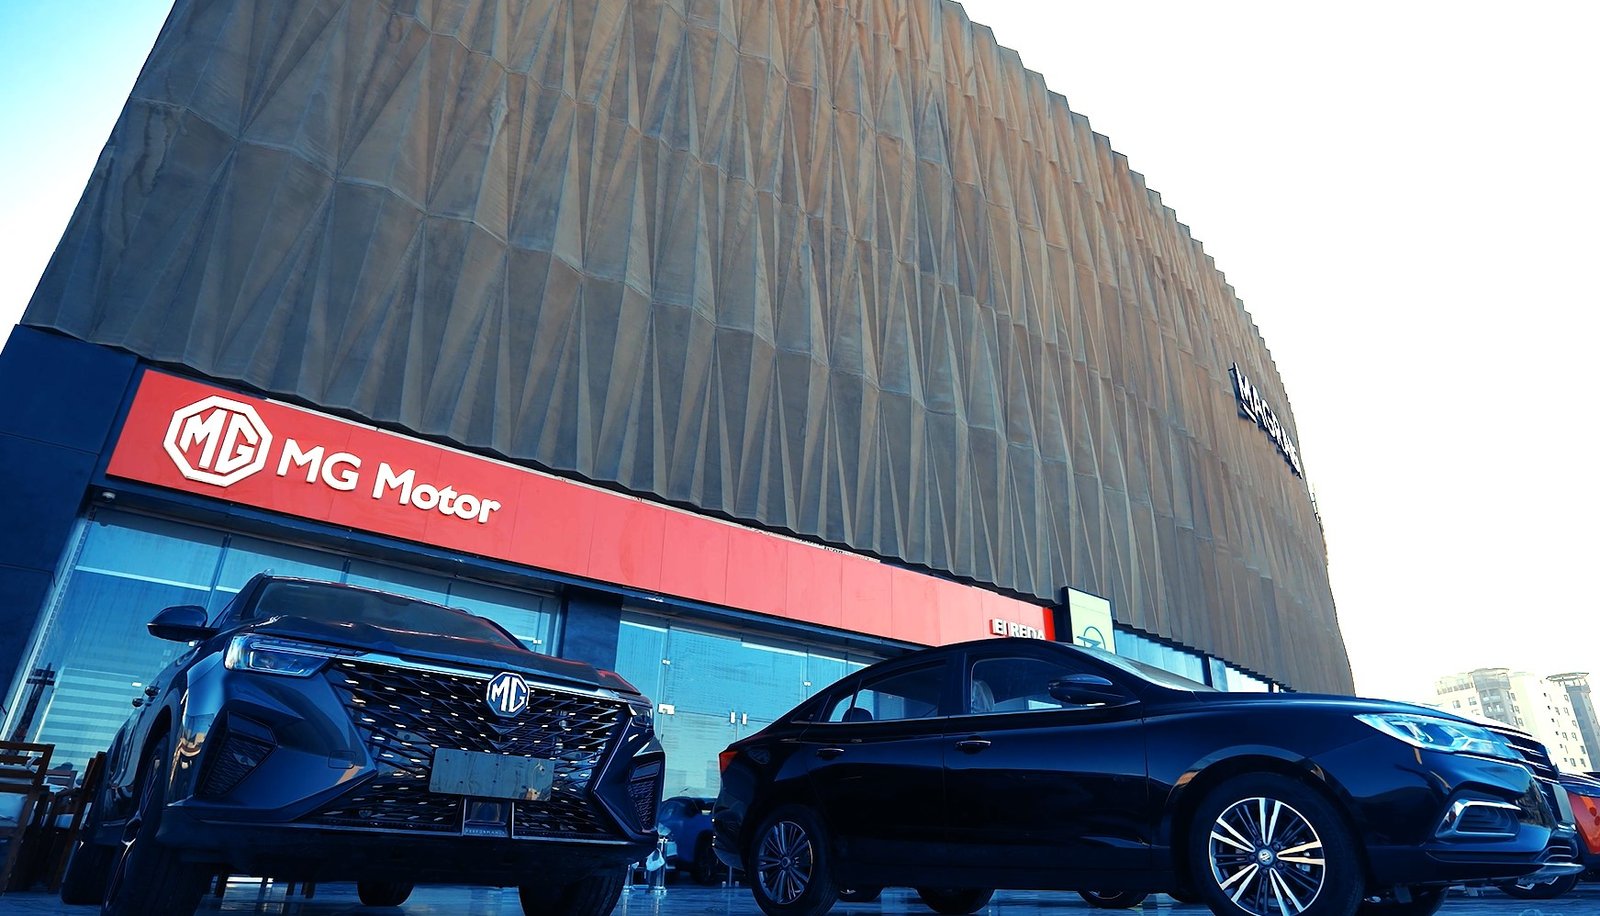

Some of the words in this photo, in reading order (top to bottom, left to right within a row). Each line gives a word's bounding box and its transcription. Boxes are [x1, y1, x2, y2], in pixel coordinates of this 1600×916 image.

[175, 404, 262, 478] MG
[276, 438, 362, 491] MG
[372, 462, 502, 523] Motor
[490, 675, 528, 713] MG
